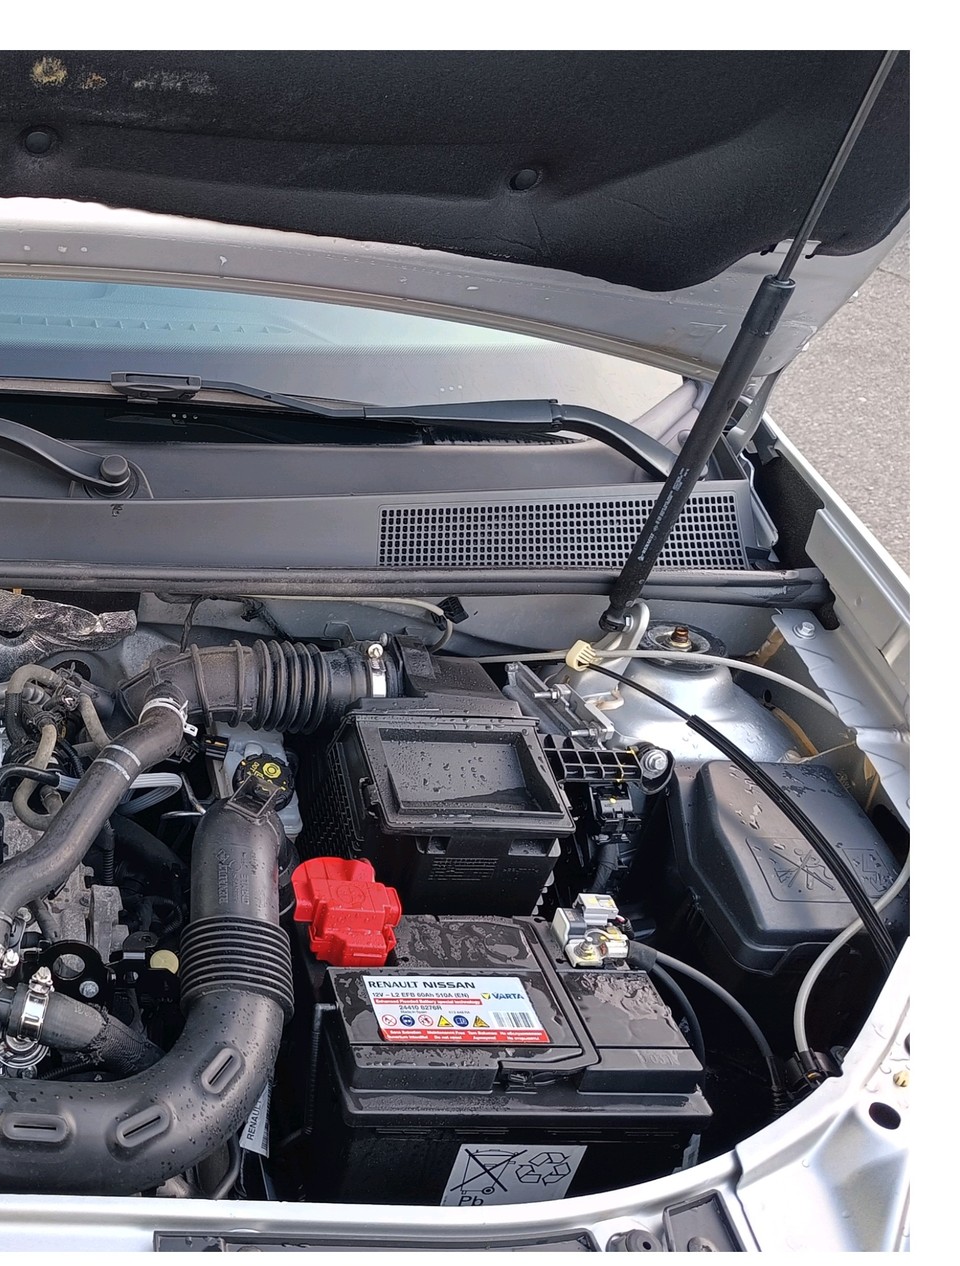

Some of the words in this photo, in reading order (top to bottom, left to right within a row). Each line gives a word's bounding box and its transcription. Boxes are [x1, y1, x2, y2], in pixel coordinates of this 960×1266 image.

[218, 864, 228, 904] RENAULT
[492, 992, 524, 1000] VARTA
[458, 1196, 484, 1206] Pb
